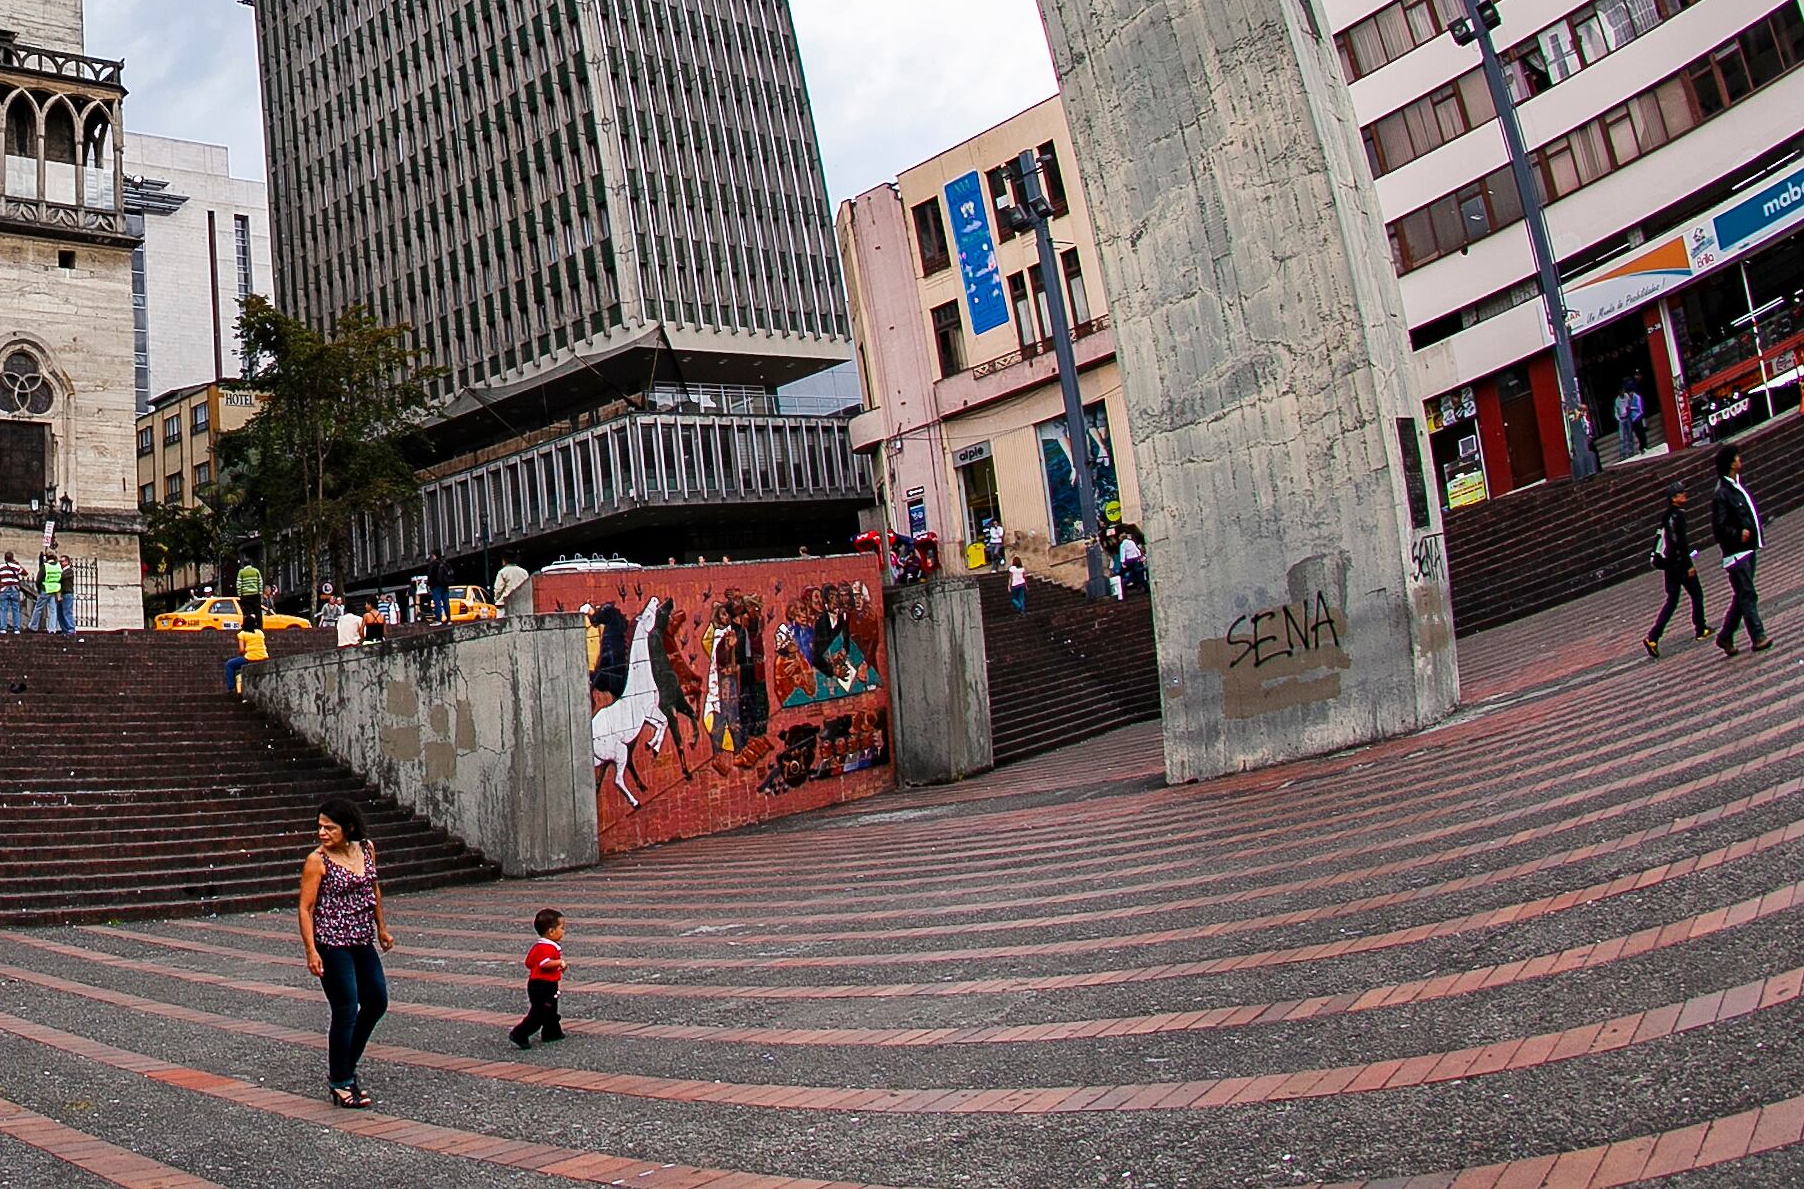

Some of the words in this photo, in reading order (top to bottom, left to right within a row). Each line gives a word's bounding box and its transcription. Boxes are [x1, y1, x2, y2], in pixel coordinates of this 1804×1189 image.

[1763, 182, 1804, 217] mab
[225, 393, 255, 406] HOTEL
[1412, 537, 1444, 581] SENA
[1226, 590, 1339, 668] SENA
